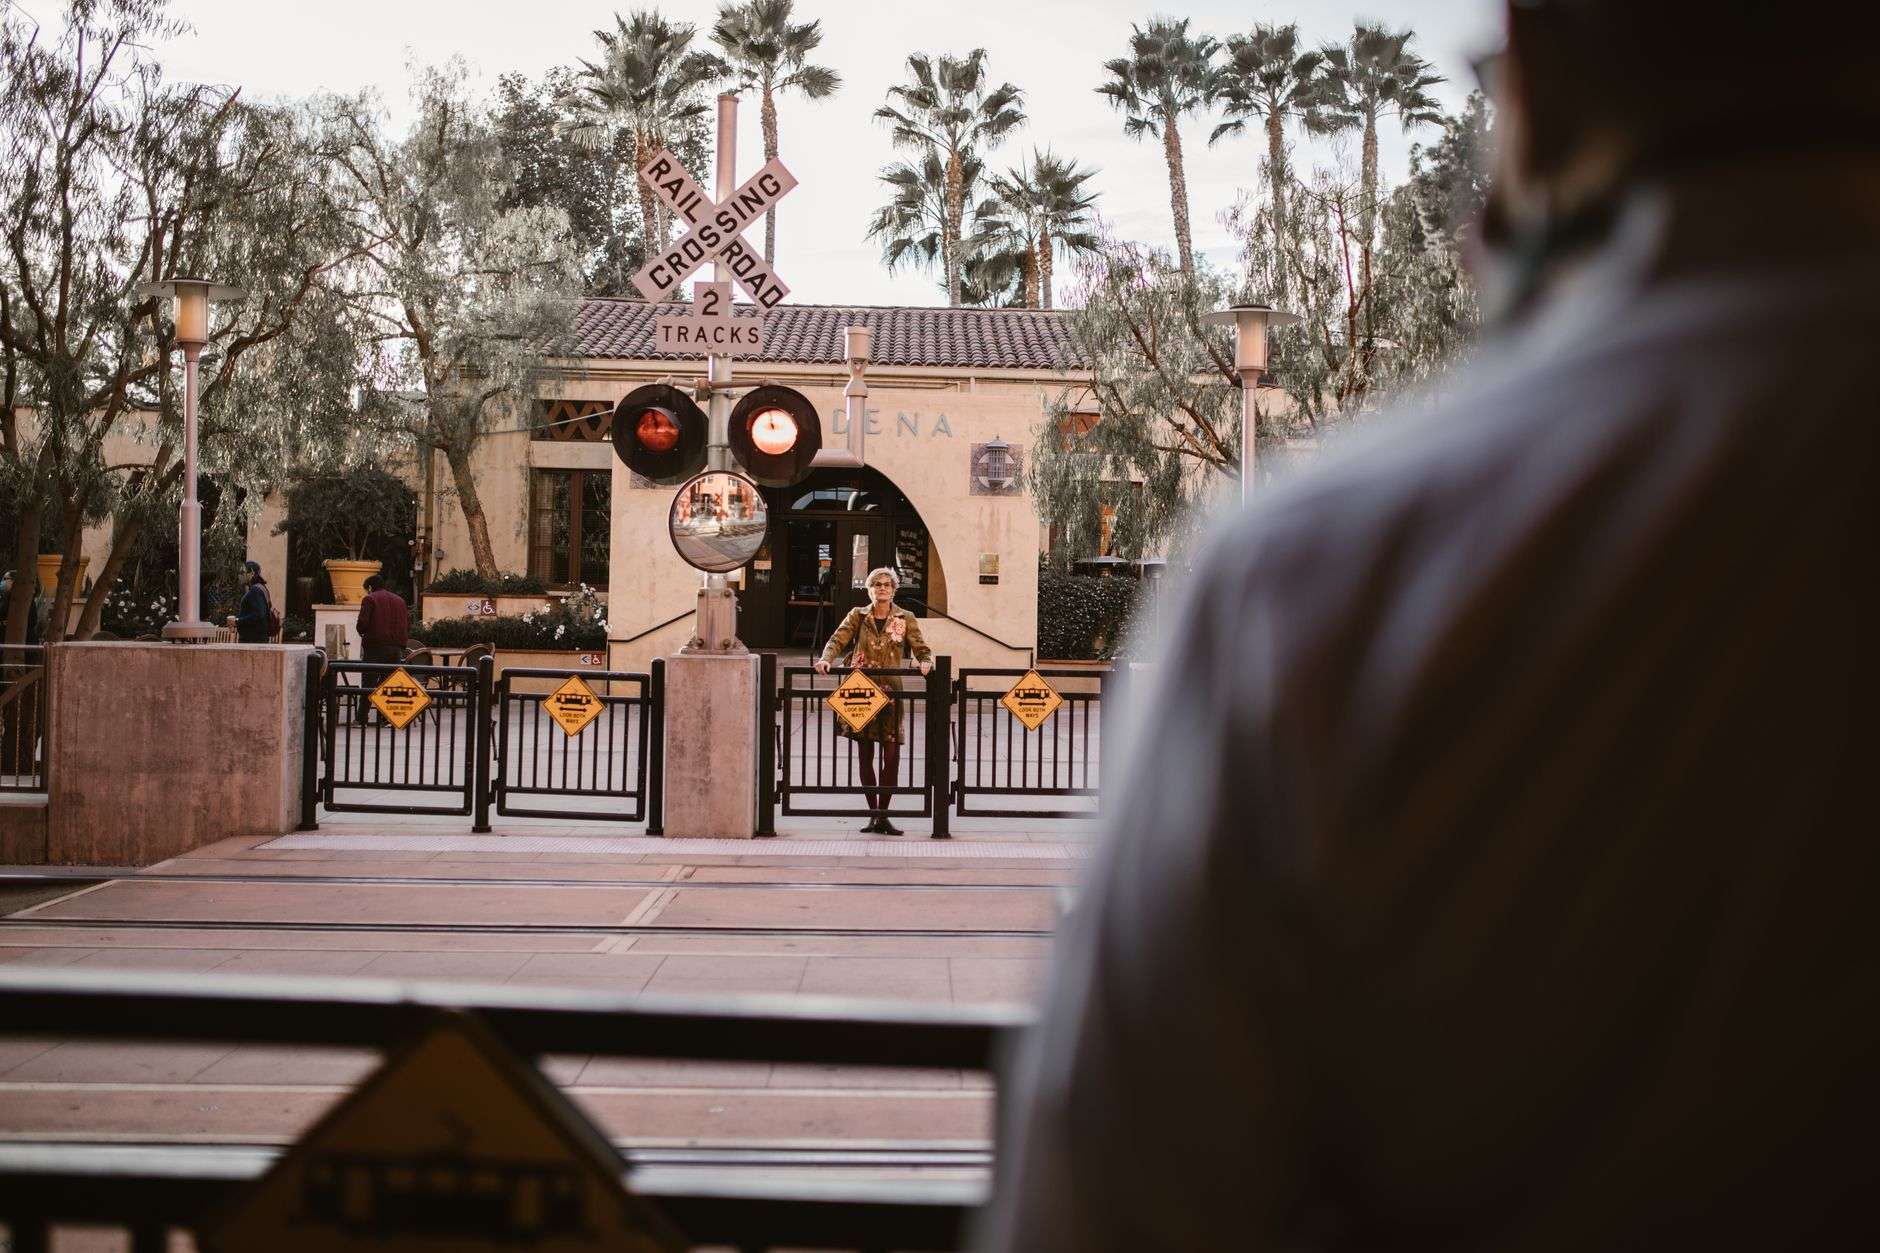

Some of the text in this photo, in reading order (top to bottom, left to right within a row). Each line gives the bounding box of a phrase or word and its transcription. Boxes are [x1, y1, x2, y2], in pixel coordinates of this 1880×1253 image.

[647, 158, 784, 309] RAIL ROAD
[648, 173, 782, 290] CROSSING
[662, 325, 760, 344] TRACKS
[702, 290, 719, 316] 2
